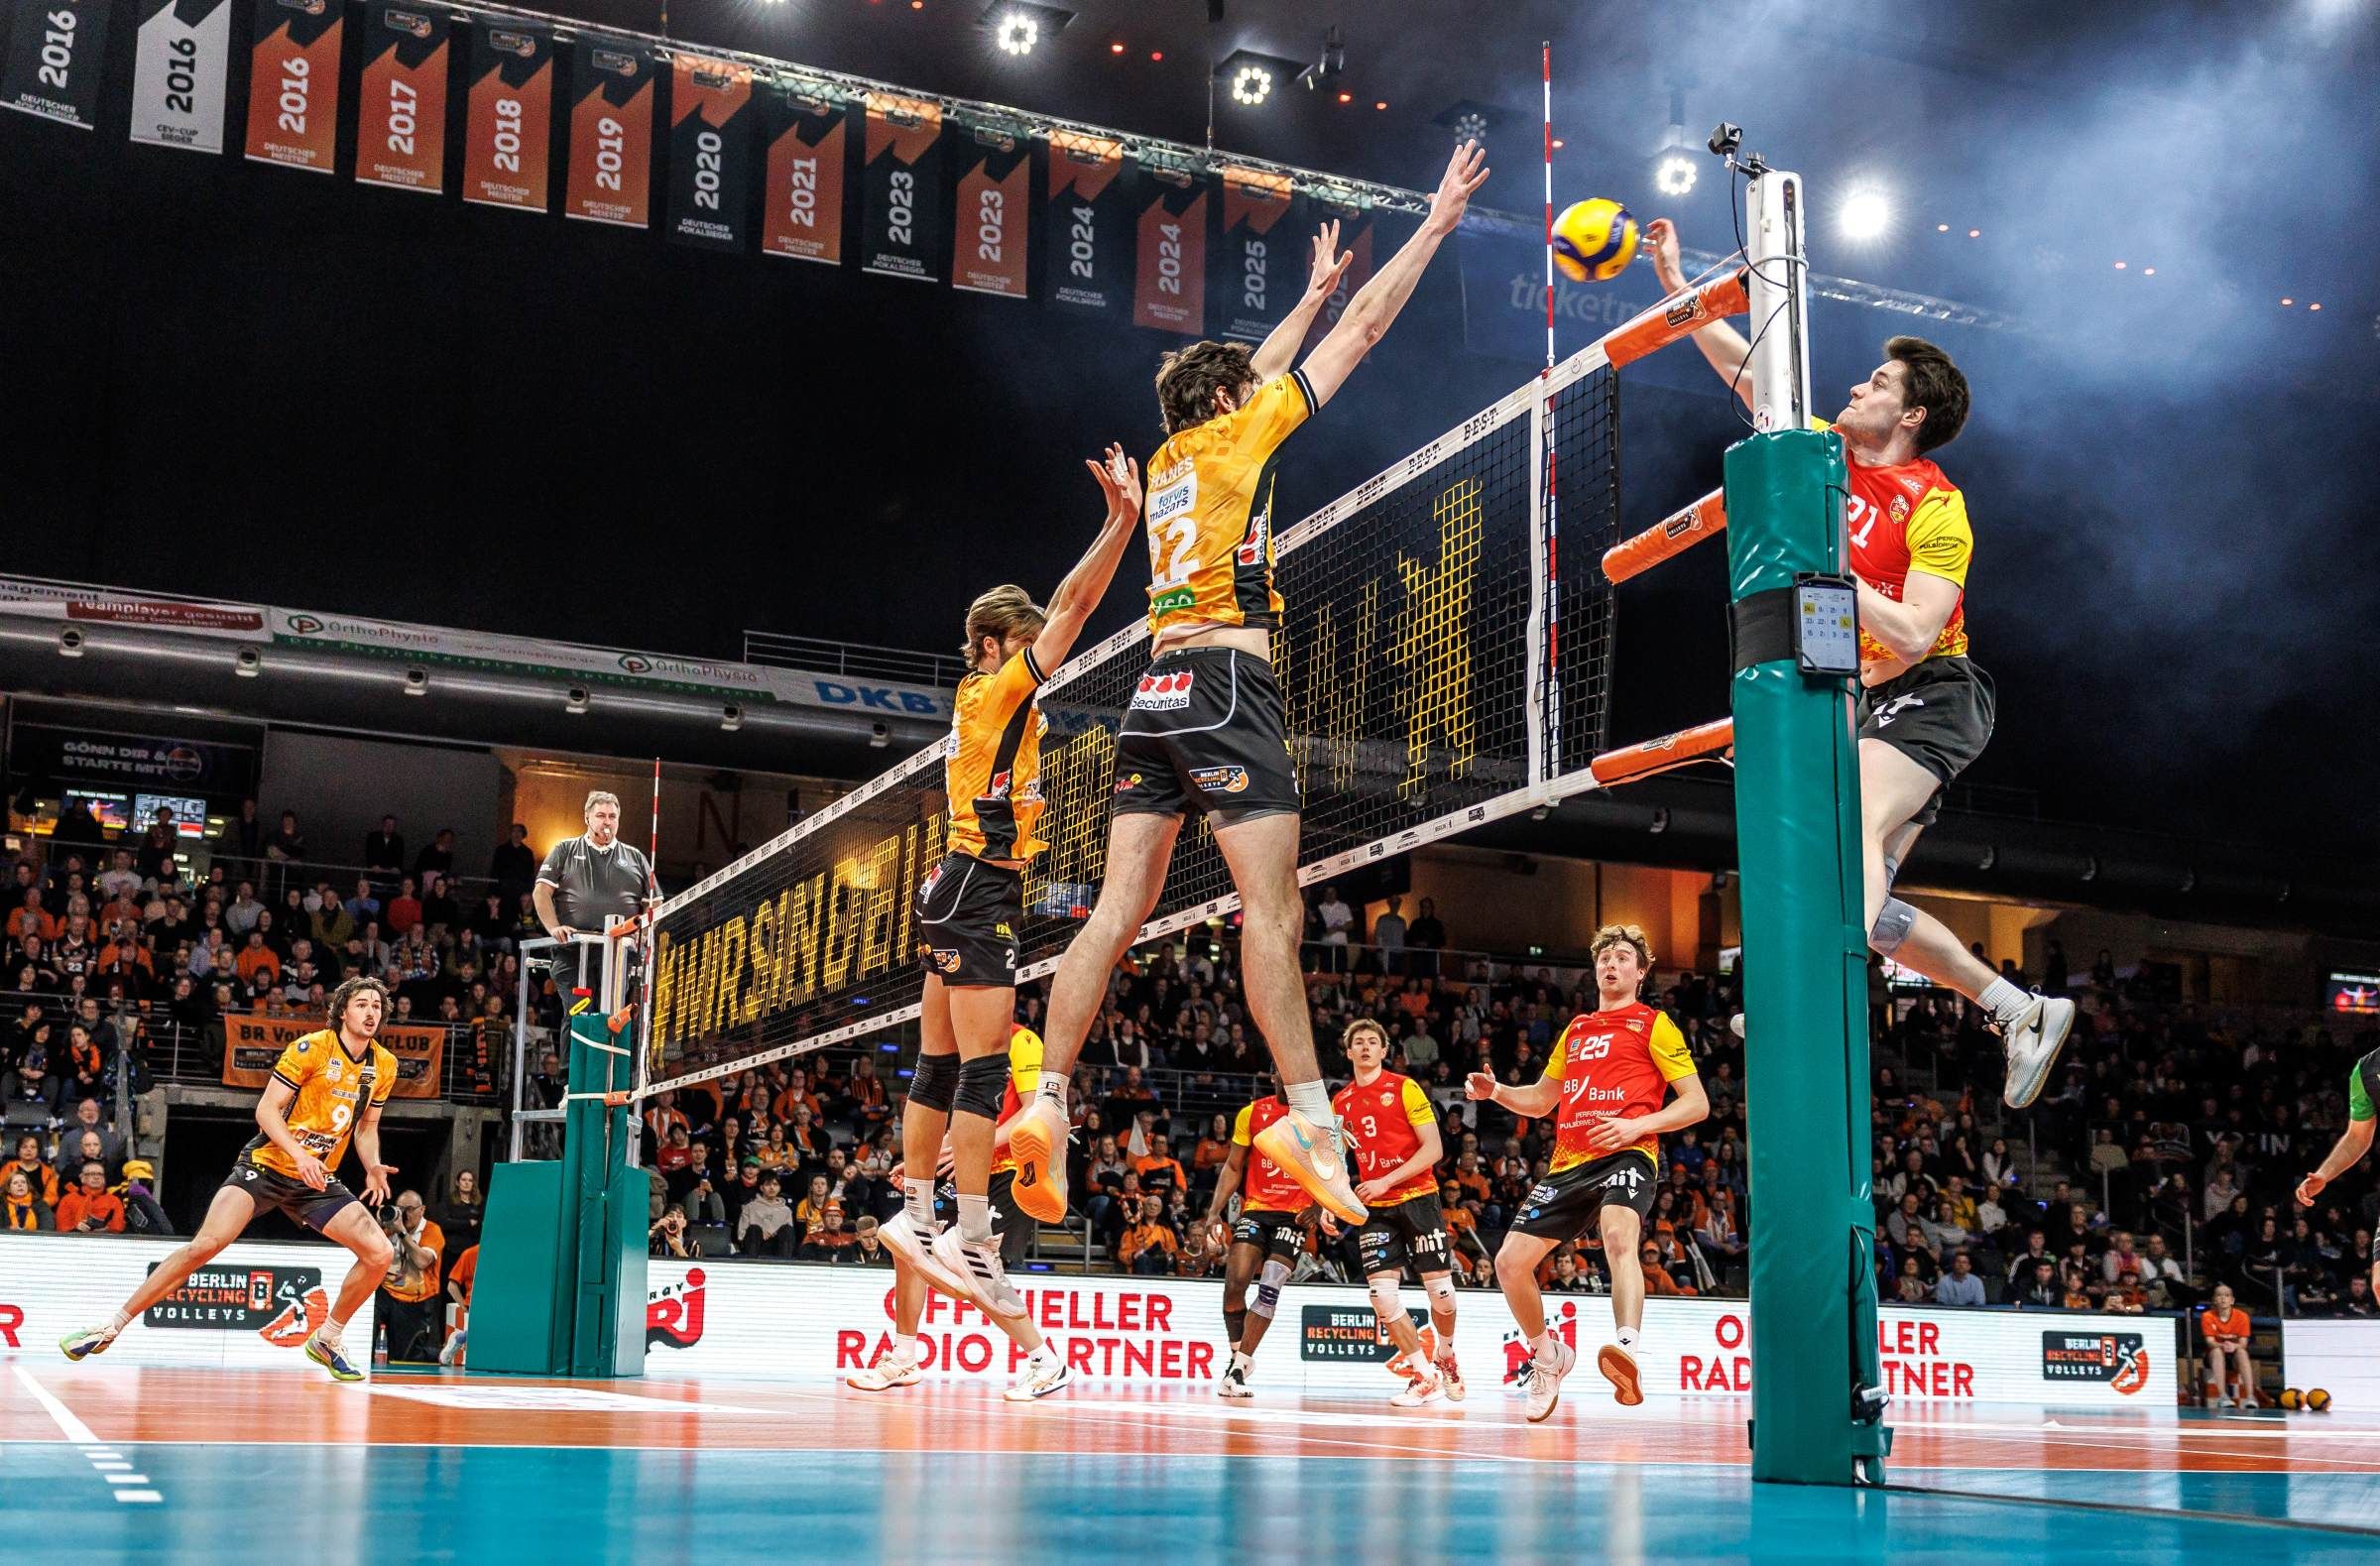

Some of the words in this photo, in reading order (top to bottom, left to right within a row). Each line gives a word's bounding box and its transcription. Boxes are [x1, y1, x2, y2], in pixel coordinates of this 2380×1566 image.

[39, 11, 76, 88] 2016
[166, 38, 196, 113] 2016
[278, 57, 309, 135] 2016
[388, 79, 416, 156] 2017
[494, 98, 522, 173] 2018
[596, 117, 623, 191] 2019
[694, 132, 722, 210] 2020
[790, 158, 817, 227] 2021
[888, 171, 914, 246] 2023
[682, 217, 730, 232] DEUTSCHER
[978, 189, 1004, 263] 2023
[1070, 206, 1094, 279] 2024
[1158, 223, 1182, 296] 2024
[1245, 240, 1267, 310] 2025
[1149, 494, 1188, 523] mazars
[1158, 484, 1188, 509] forvis
[1149, 516, 1200, 587] 22
[813, 680, 938, 715] DKB
[1131, 696, 1188, 710] Securitas
[62, 756, 133, 773] STARTE
[1006, 948, 1014, 970] 2
[1580, 1033, 1614, 1061] 25
[1564, 1078, 1579, 1094] BB
[1589, 1087, 1624, 1101] Bank
[331, 1104, 351, 1133] 9
[1361, 1115, 1377, 1138] 3
[245, 1170, 258, 1180] 9
[1415, 1228, 1447, 1254] init
[187, 1273, 247, 1289] BERLIN
[153, 1306, 246, 1321] VOLLEYS
[1331, 1313, 1375, 1328] BERLIN
[1307, 1327, 1375, 1340] RECYCLING
[2065, 1338, 2101, 1350] BERLIN
[836, 1330, 994, 1373] RADIO
[1007, 1336, 1215, 1380] PRTNER
[1307, 1343, 1375, 1356] VOLLEYS
[2047, 1364, 2102, 1376] VOLLEYS
